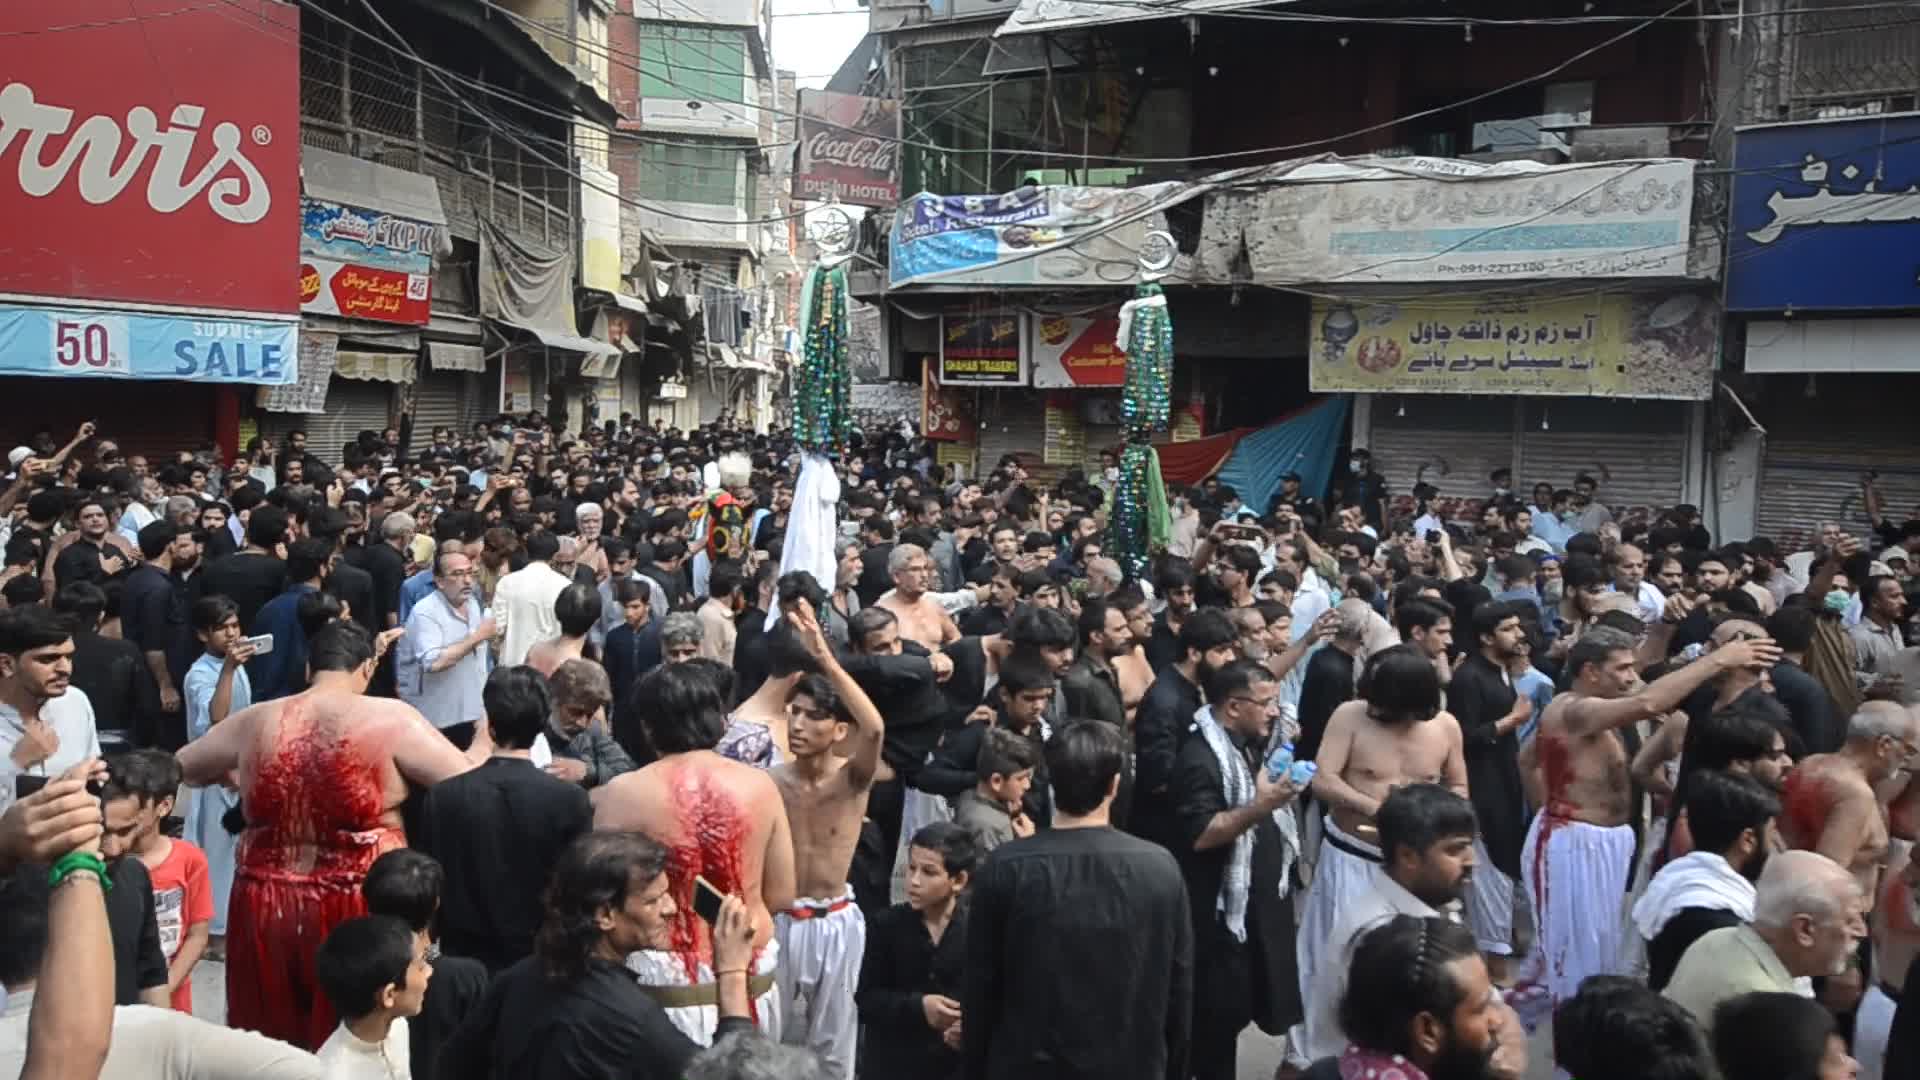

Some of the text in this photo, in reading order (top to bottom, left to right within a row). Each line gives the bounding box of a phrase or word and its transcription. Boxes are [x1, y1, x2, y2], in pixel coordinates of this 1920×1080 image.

[804, 181, 894, 201] DUBI HOTEL
[56, 321, 108, 366] 50
[1505, 322, 1530, 345] زم
[1535, 322, 1559, 345] زم
[174, 340, 282, 378] SALE
